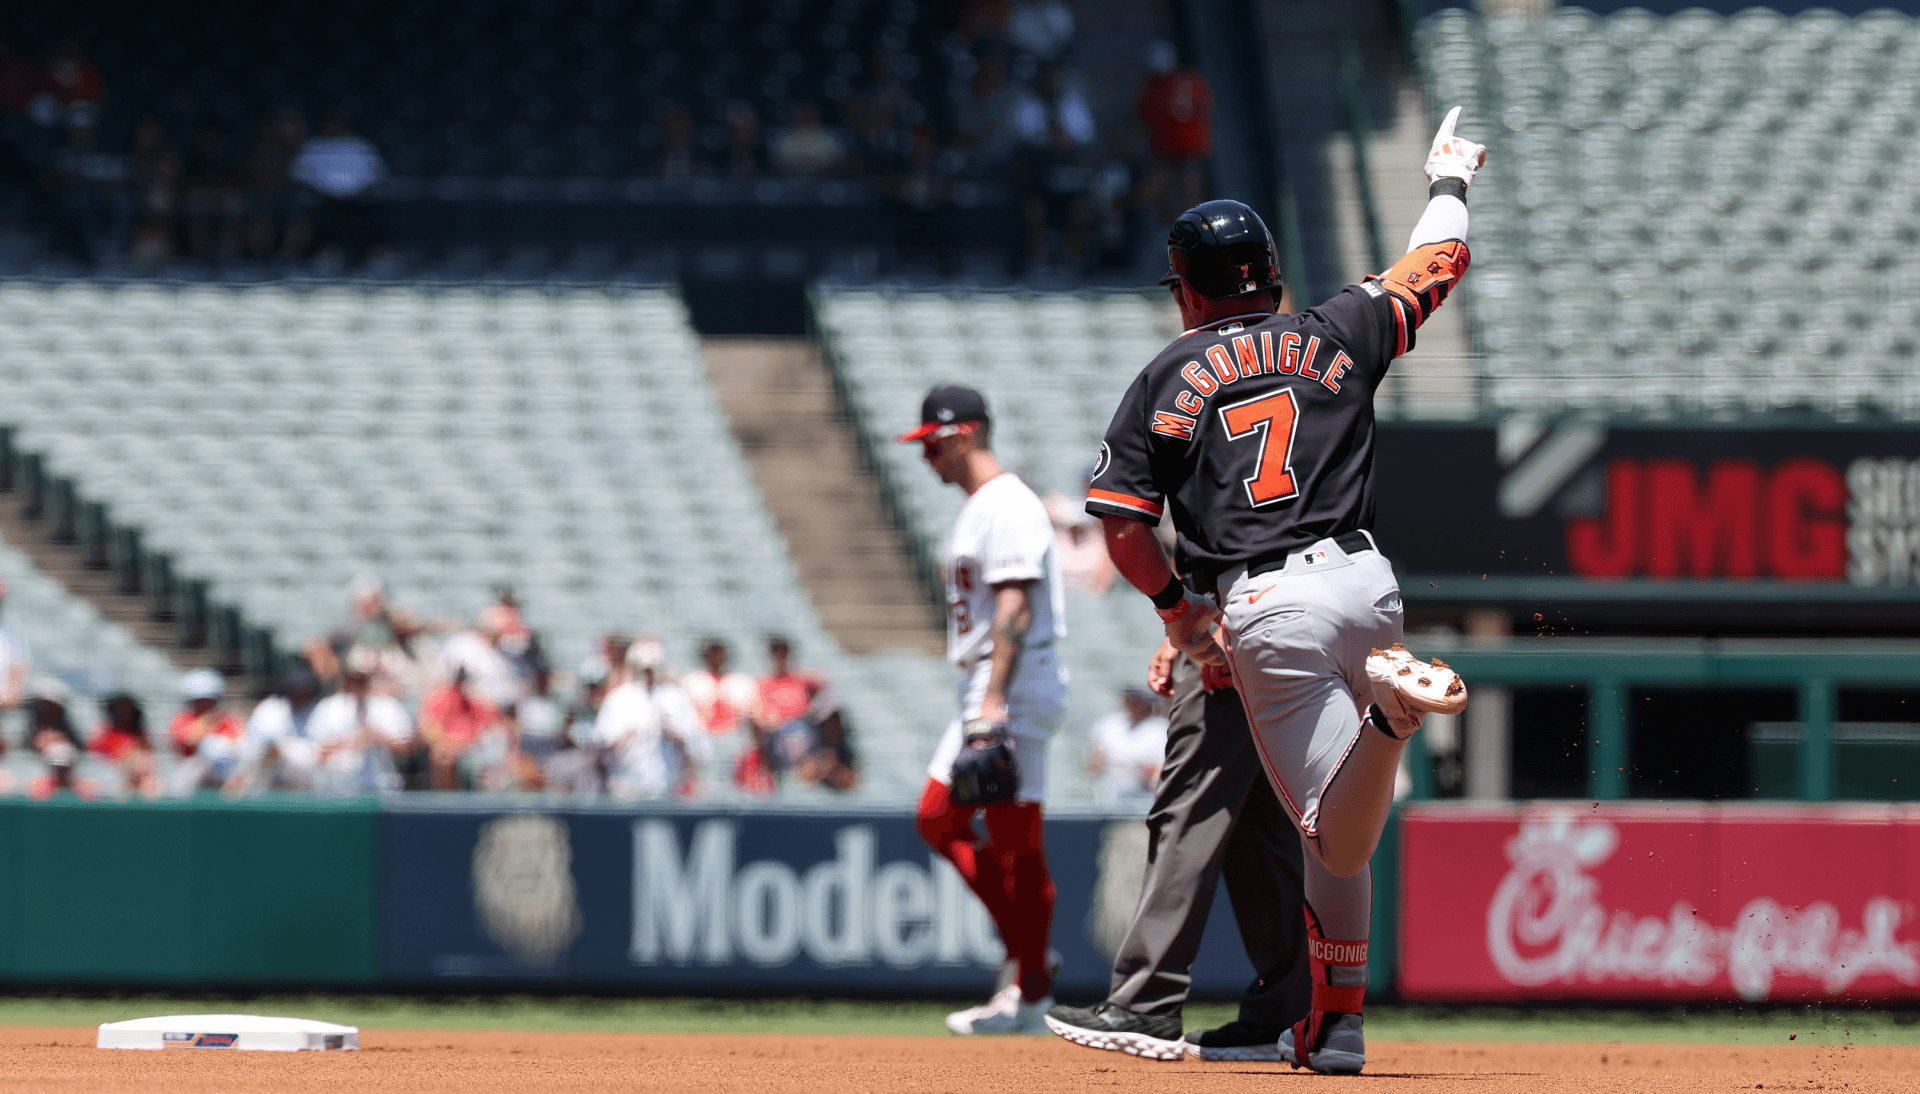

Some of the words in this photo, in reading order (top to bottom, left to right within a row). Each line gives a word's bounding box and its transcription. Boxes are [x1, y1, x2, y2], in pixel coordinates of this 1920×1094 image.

[1240, 265, 1249, 279] 7
[1217, 386, 1300, 509] 7
[1567, 457, 1847, 582] JMG
